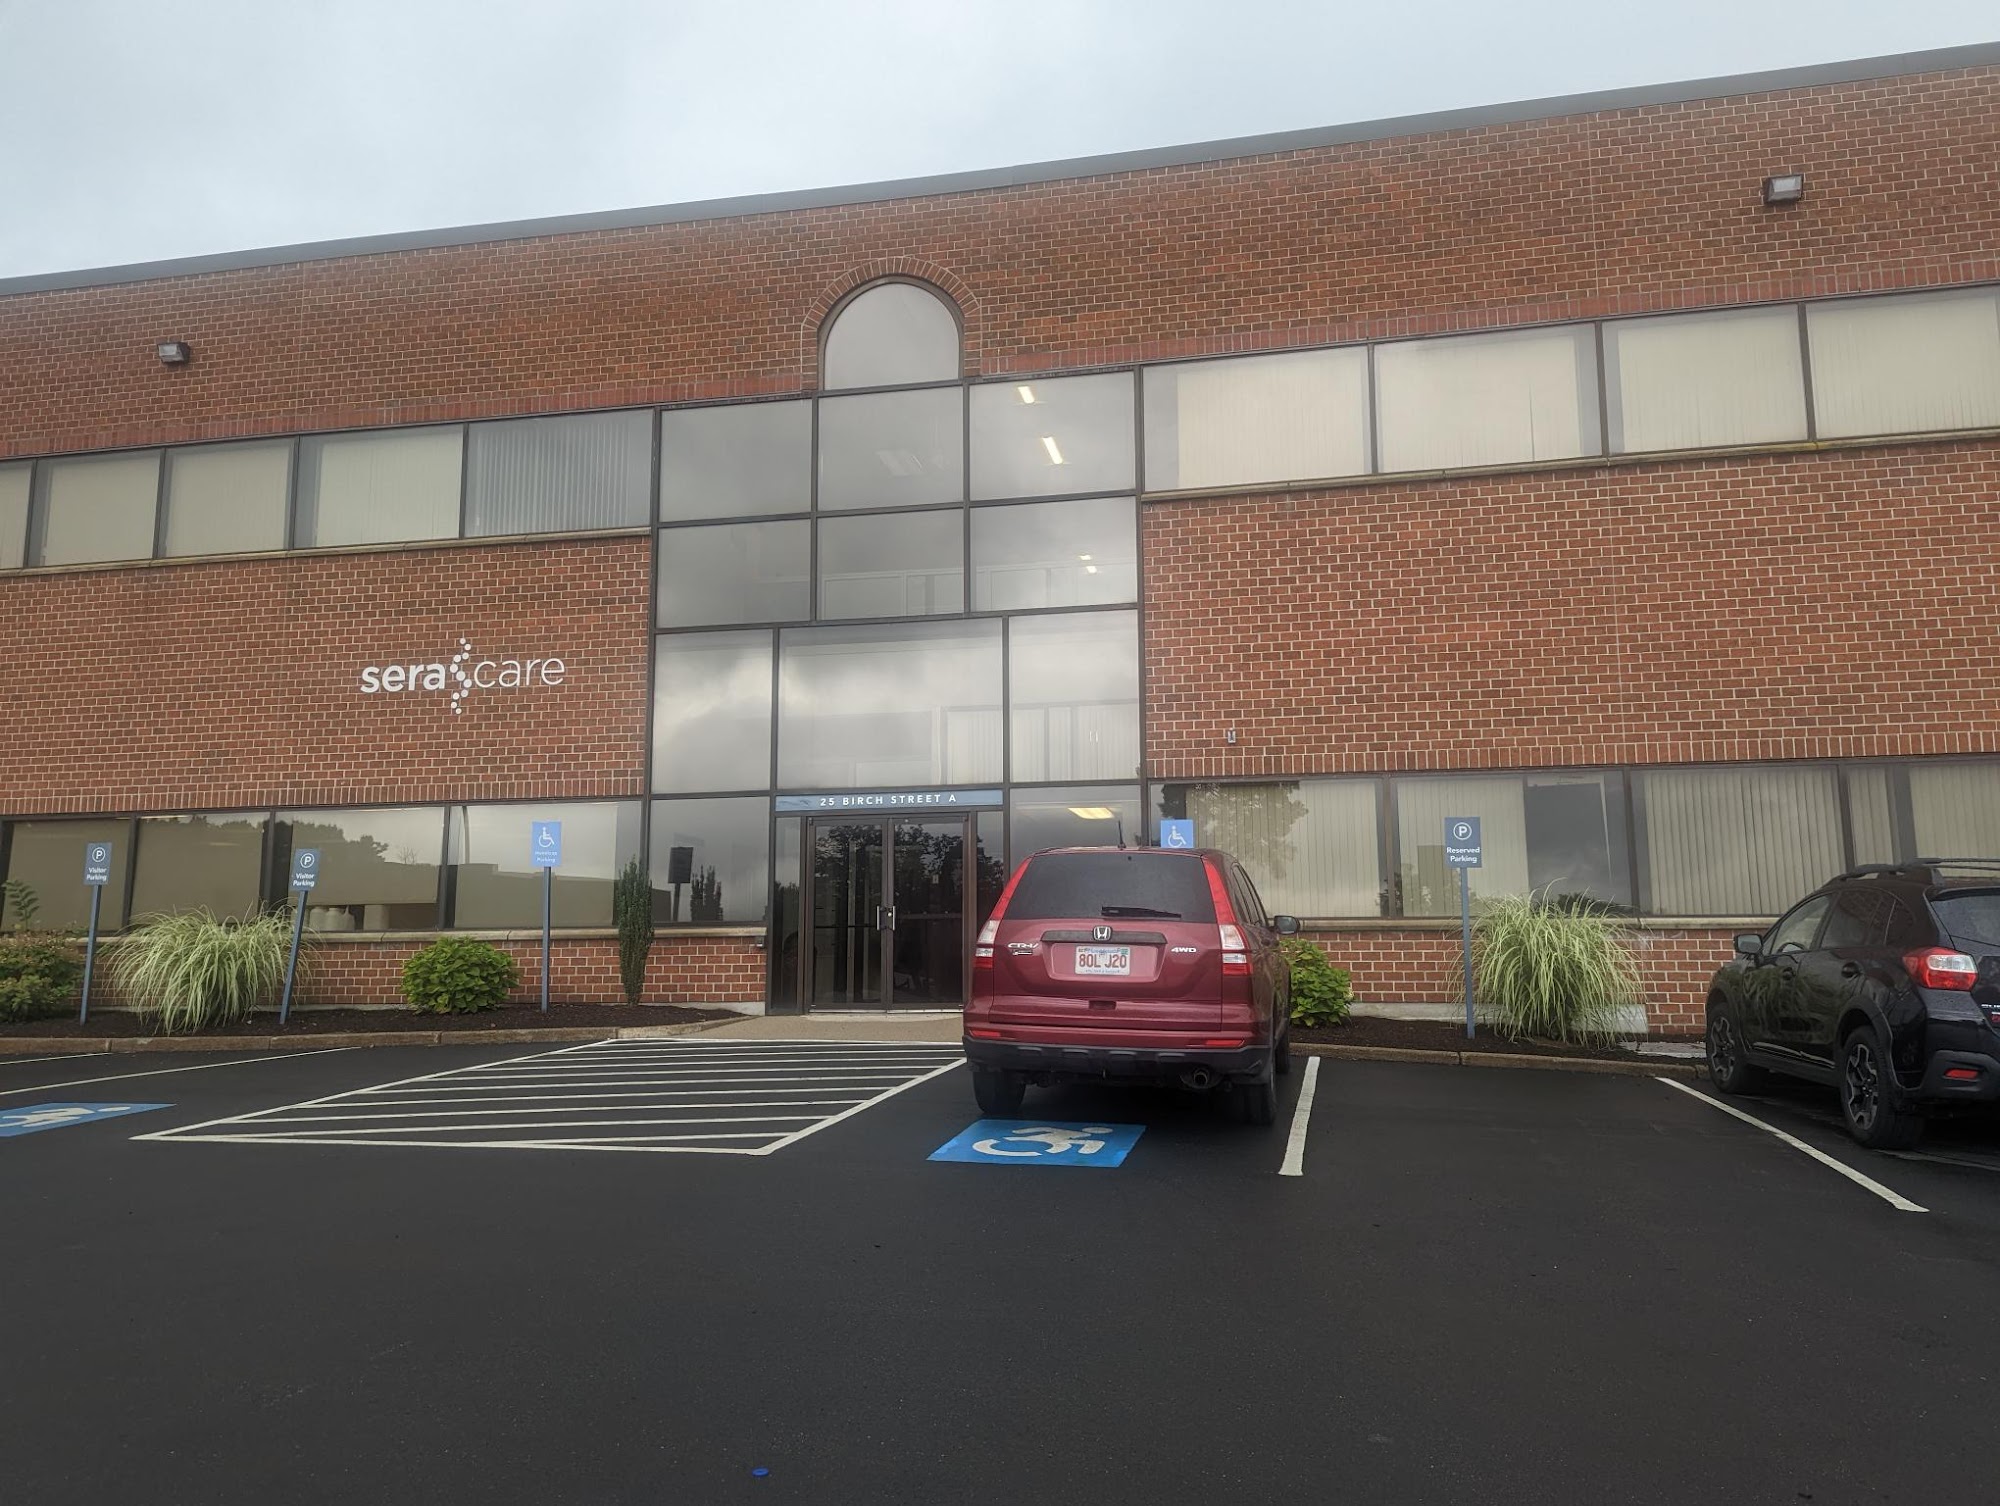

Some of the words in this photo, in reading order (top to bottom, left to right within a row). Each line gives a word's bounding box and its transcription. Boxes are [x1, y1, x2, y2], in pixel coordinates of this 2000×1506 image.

[360, 663, 446, 694] sera
[473, 657, 566, 688] care
[820, 797, 835, 806] 25
[842, 796, 883, 806] BIRCH
[890, 794, 941, 804] STREET
[948, 794, 957, 802] A
[1446, 846, 1481, 854] Reserved
[1450, 855, 1478, 864] Parking
[86, 874, 107, 882] Parking
[295, 872, 315, 880] Visitor
[292, 879, 315, 888] Parking
[1079, 953, 1101, 968] 80L
[1104, 954, 1127, 969] J20
